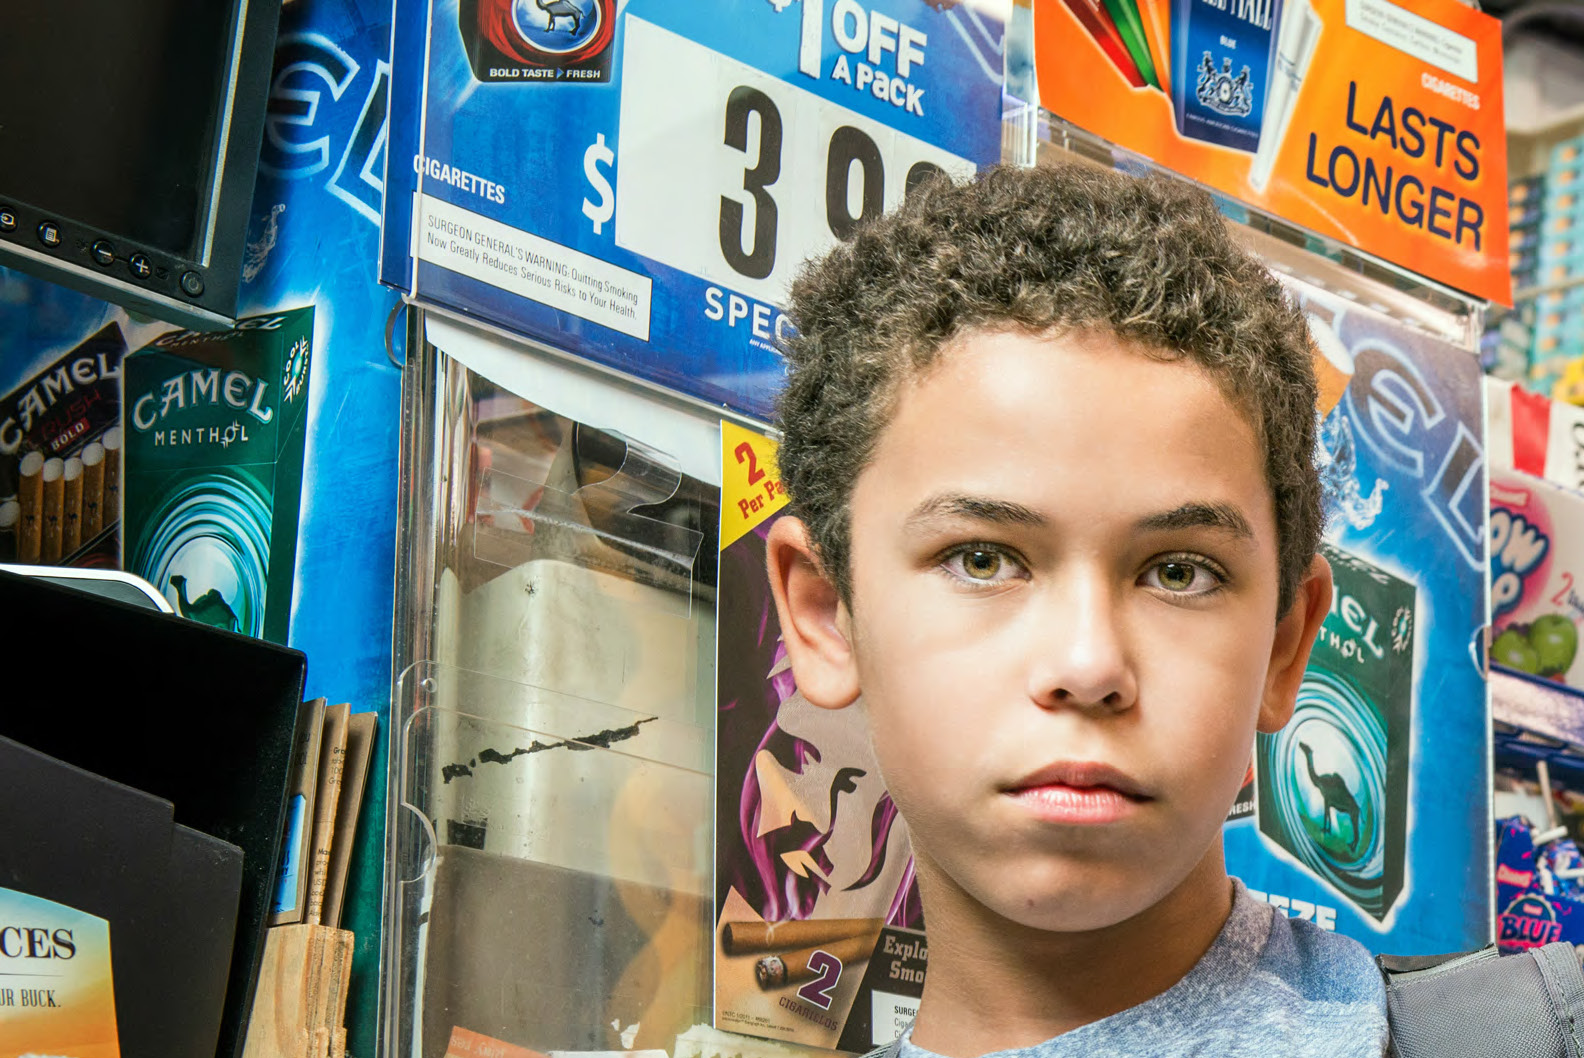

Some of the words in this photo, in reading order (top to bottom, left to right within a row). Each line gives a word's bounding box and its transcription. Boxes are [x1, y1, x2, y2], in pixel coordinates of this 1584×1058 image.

[831, 0, 927, 78] OFF
[489, 67, 520, 78] BOLD
[521, 68, 554, 78] TASTE
[566, 69, 601, 79] FRESH
[831, 54, 852, 85] A
[1345, 80, 1481, 182] LASTS
[413, 154, 505, 204] CIGARETTES
[582, 133, 616, 236] $
[718, 84, 784, 280] 3
[1305, 131, 1484, 252] LONGER
[427, 214, 473, 243] SURGEON
[474, 231, 524, 261] GENERAL'S
[524, 250, 571, 278] WARNING:
[571, 268, 603, 293] Quitting
[604, 281, 639, 305] Smoking
[427, 231, 448, 250] Now
[450, 240, 480, 264] Greatly
[482, 251, 518, 276] Reduces
[520, 263, 552, 288] Serious
[554, 278, 576, 298] Risks
[578, 289, 588, 301] to
[589, 292, 607, 309] Your
[609, 300, 638, 321] Health.
[0, 353, 120, 452] CAMEL
[131, 367, 274, 433] CAMEL
[51, 421, 86, 450] BOLD
[154, 420, 249, 448] MENTHOL
[734, 441, 766, 487] 2
[737, 493, 764, 520] Per
[763, 480, 785, 501] Pa
[1498, 913, 1562, 944] BLUE
[21, 988, 62, 1008] BUCK.
[796, 950, 843, 1011] 2
[778, 996, 839, 1031] CIGARILLOS
